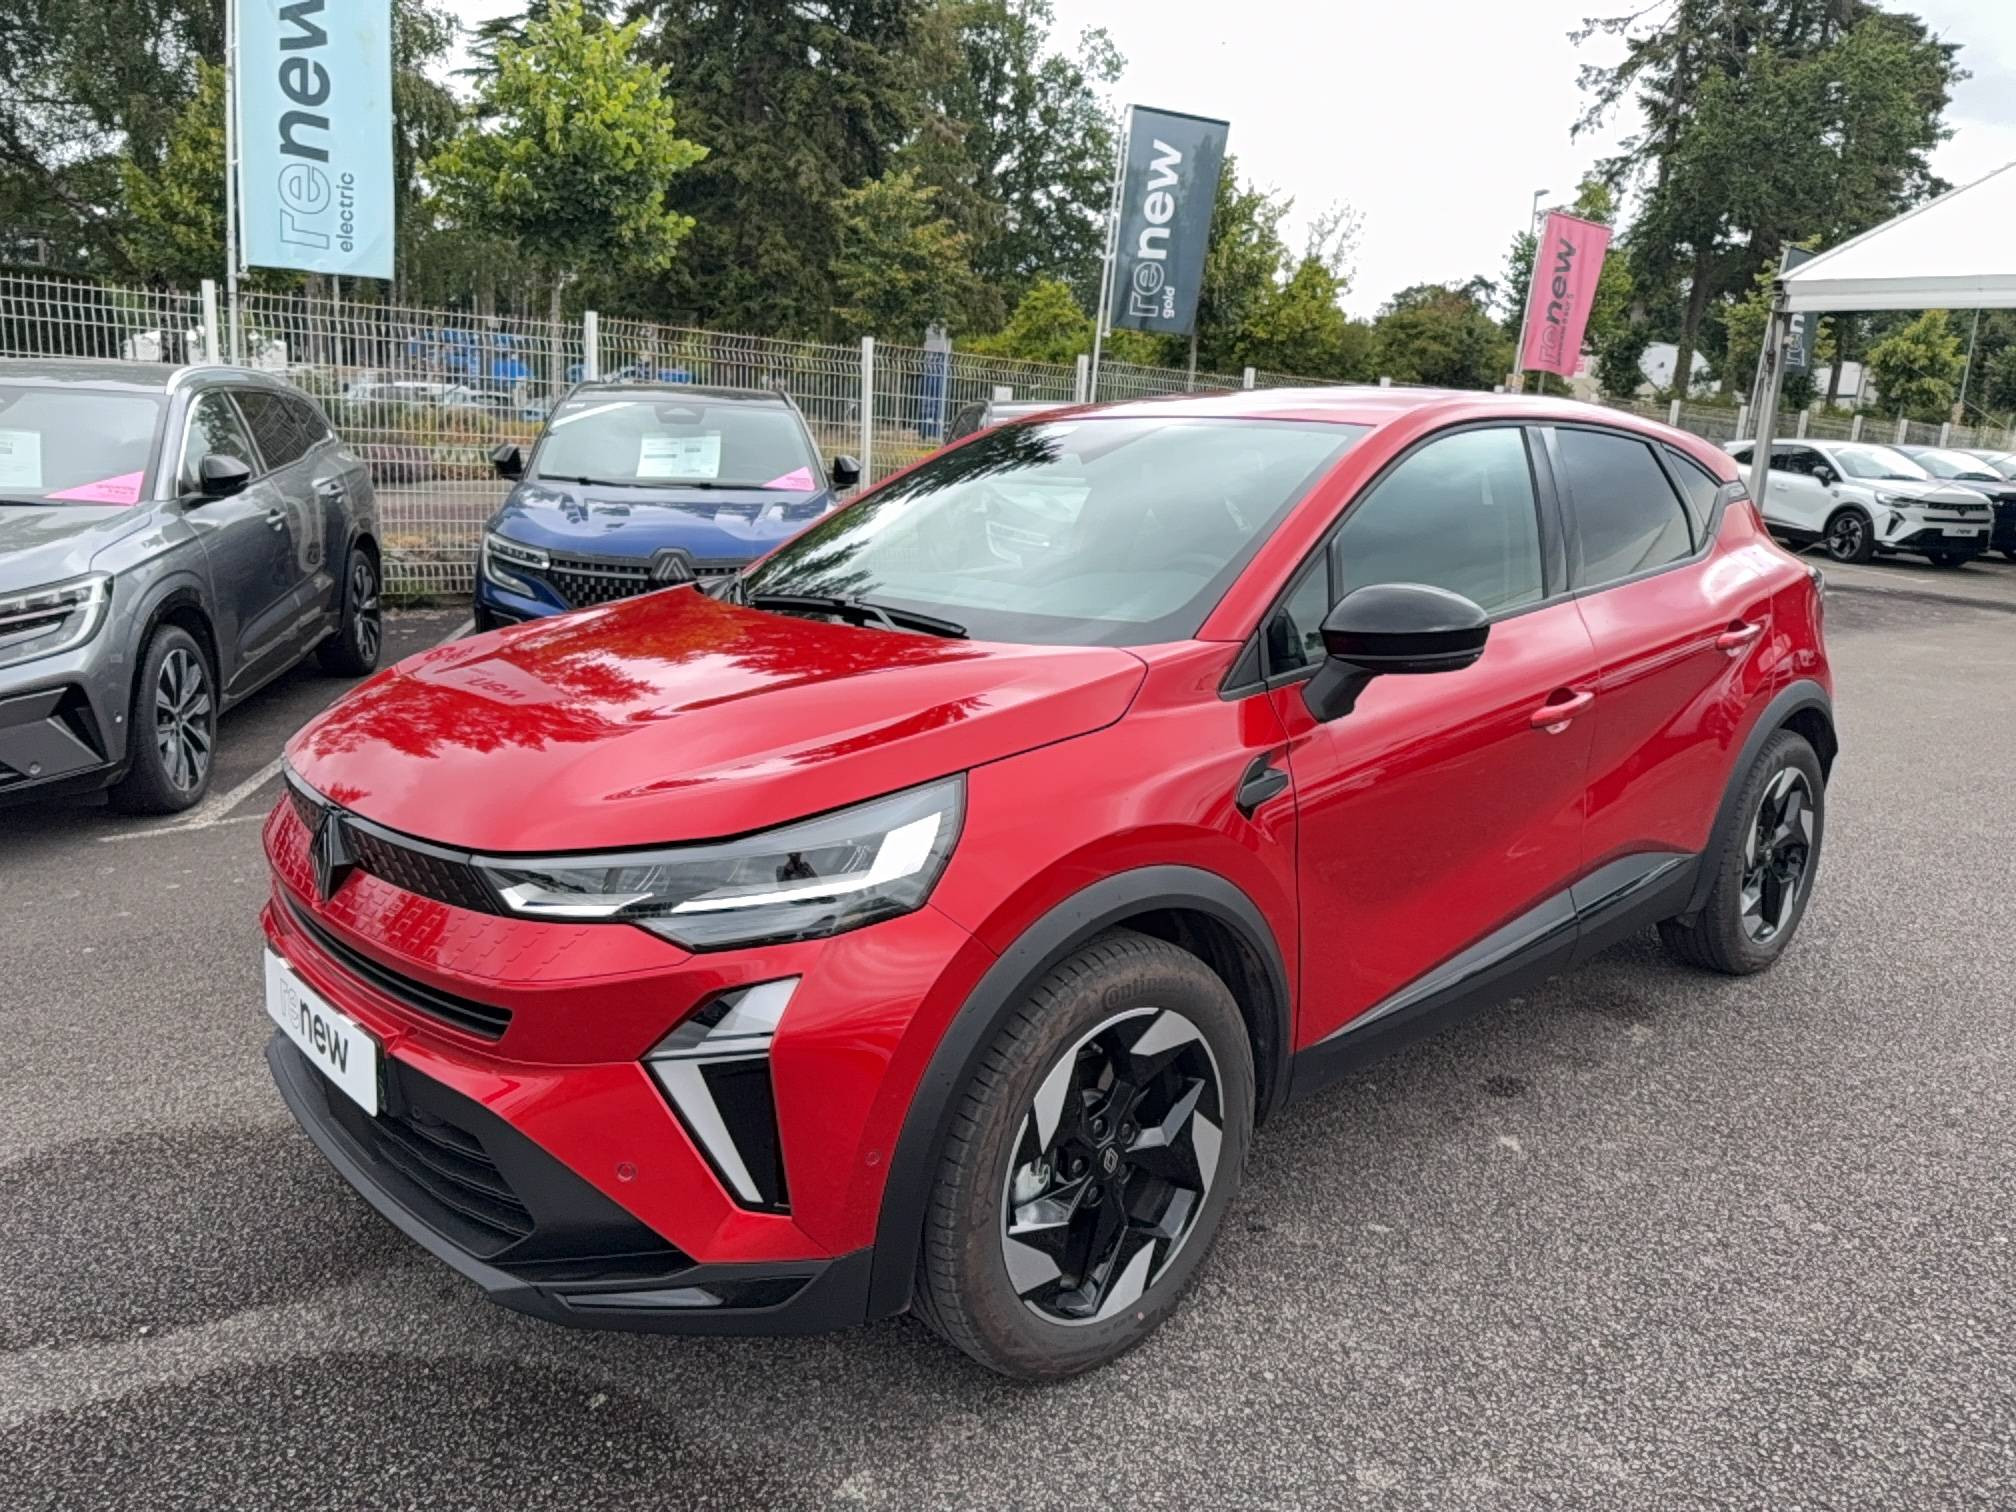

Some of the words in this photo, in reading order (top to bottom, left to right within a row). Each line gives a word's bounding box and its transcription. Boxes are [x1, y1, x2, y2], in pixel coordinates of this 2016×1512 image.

[278, 0, 331, 250] renew
[336, 172, 354, 252] electric
[1129, 139, 1182, 317] renew
[1162, 286, 1175, 319] gold
[1539, 238, 1577, 366] renew
[279, 978, 348, 1074] renew
